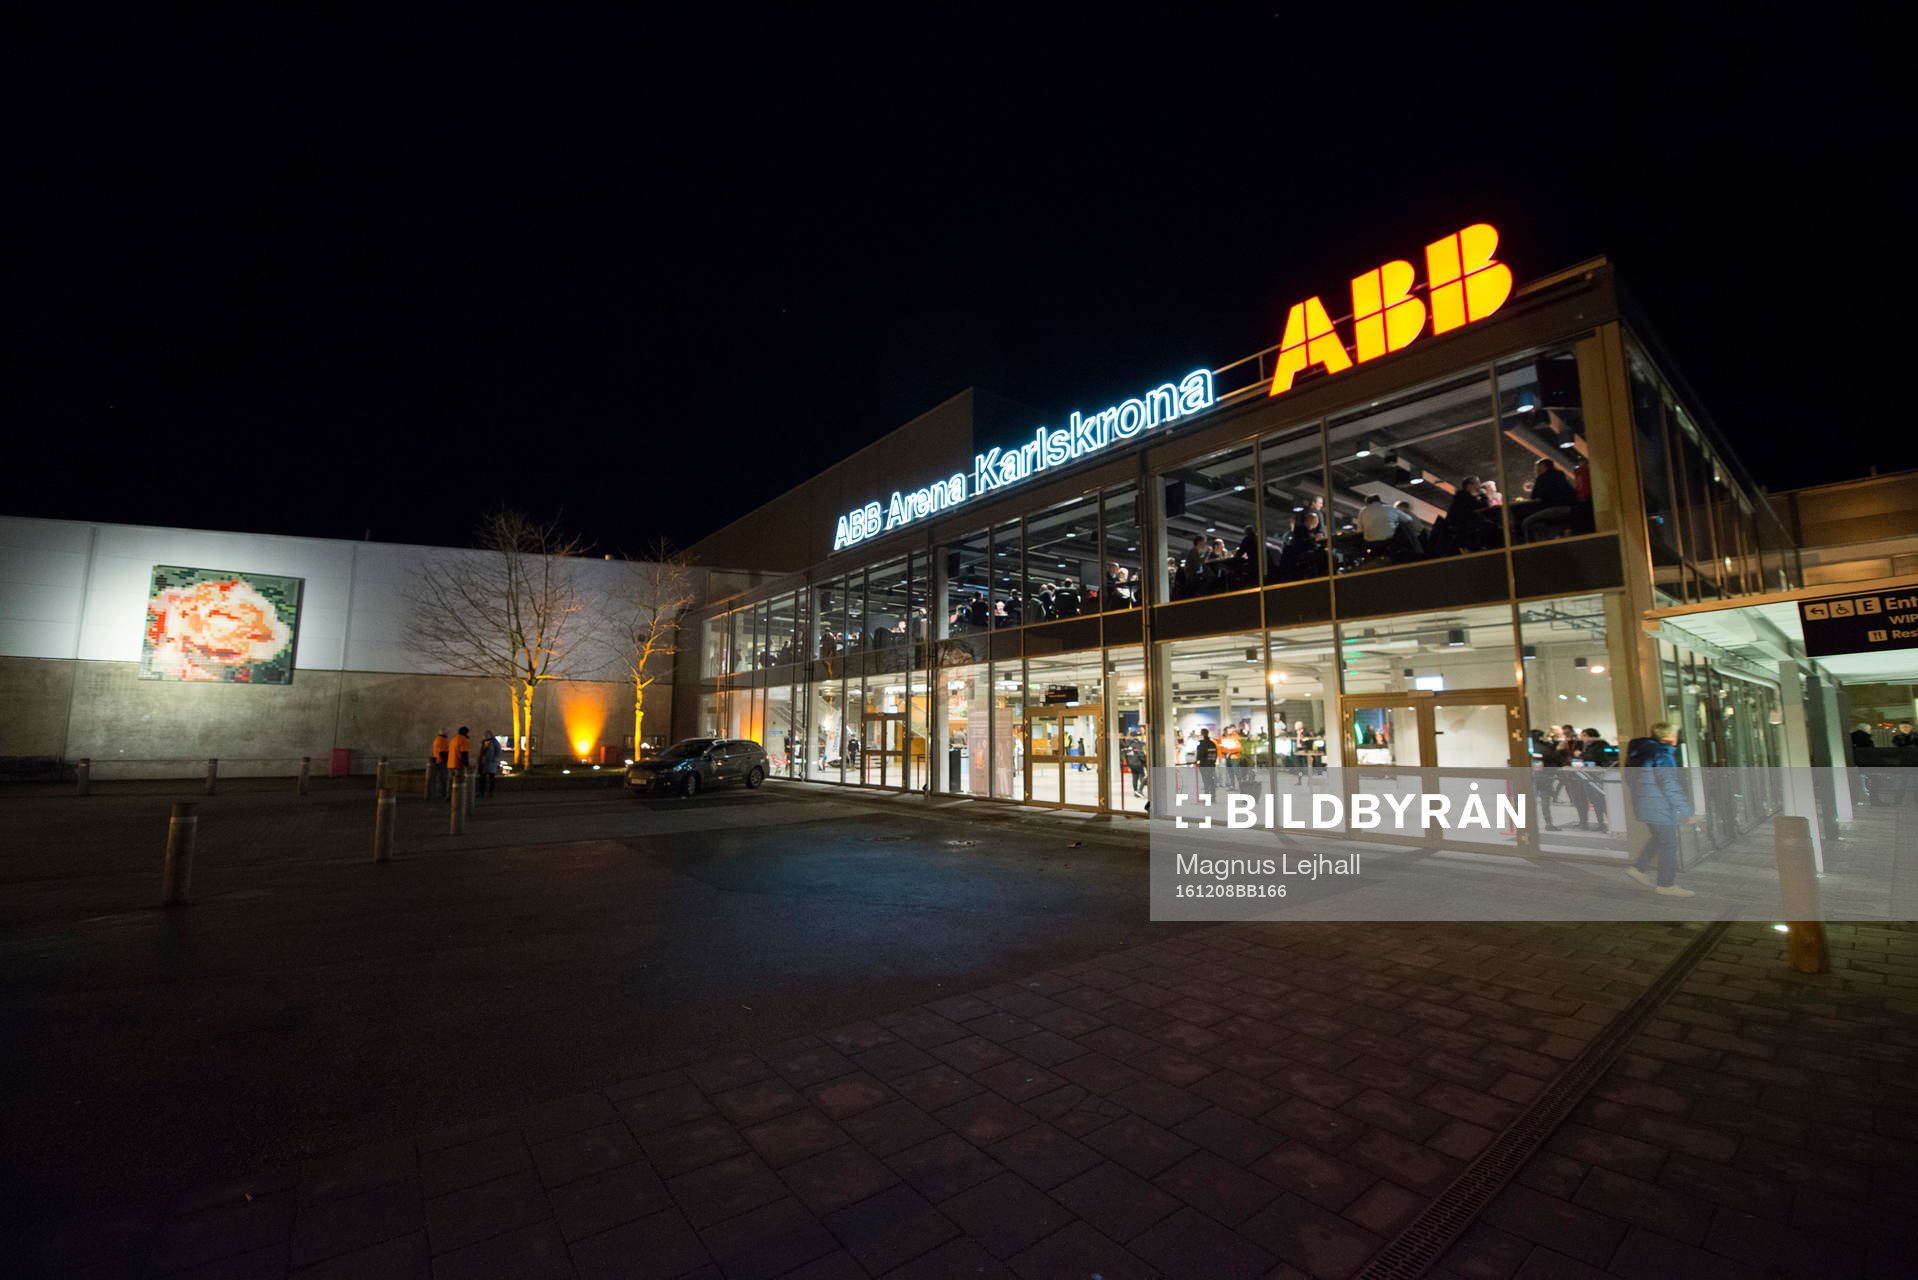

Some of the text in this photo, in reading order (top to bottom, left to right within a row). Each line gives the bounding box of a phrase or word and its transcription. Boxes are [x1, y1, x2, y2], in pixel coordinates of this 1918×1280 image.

[1269, 223, 1513, 397] ABB
[833, 367, 1215, 551] ABB Arena Karlskrona
